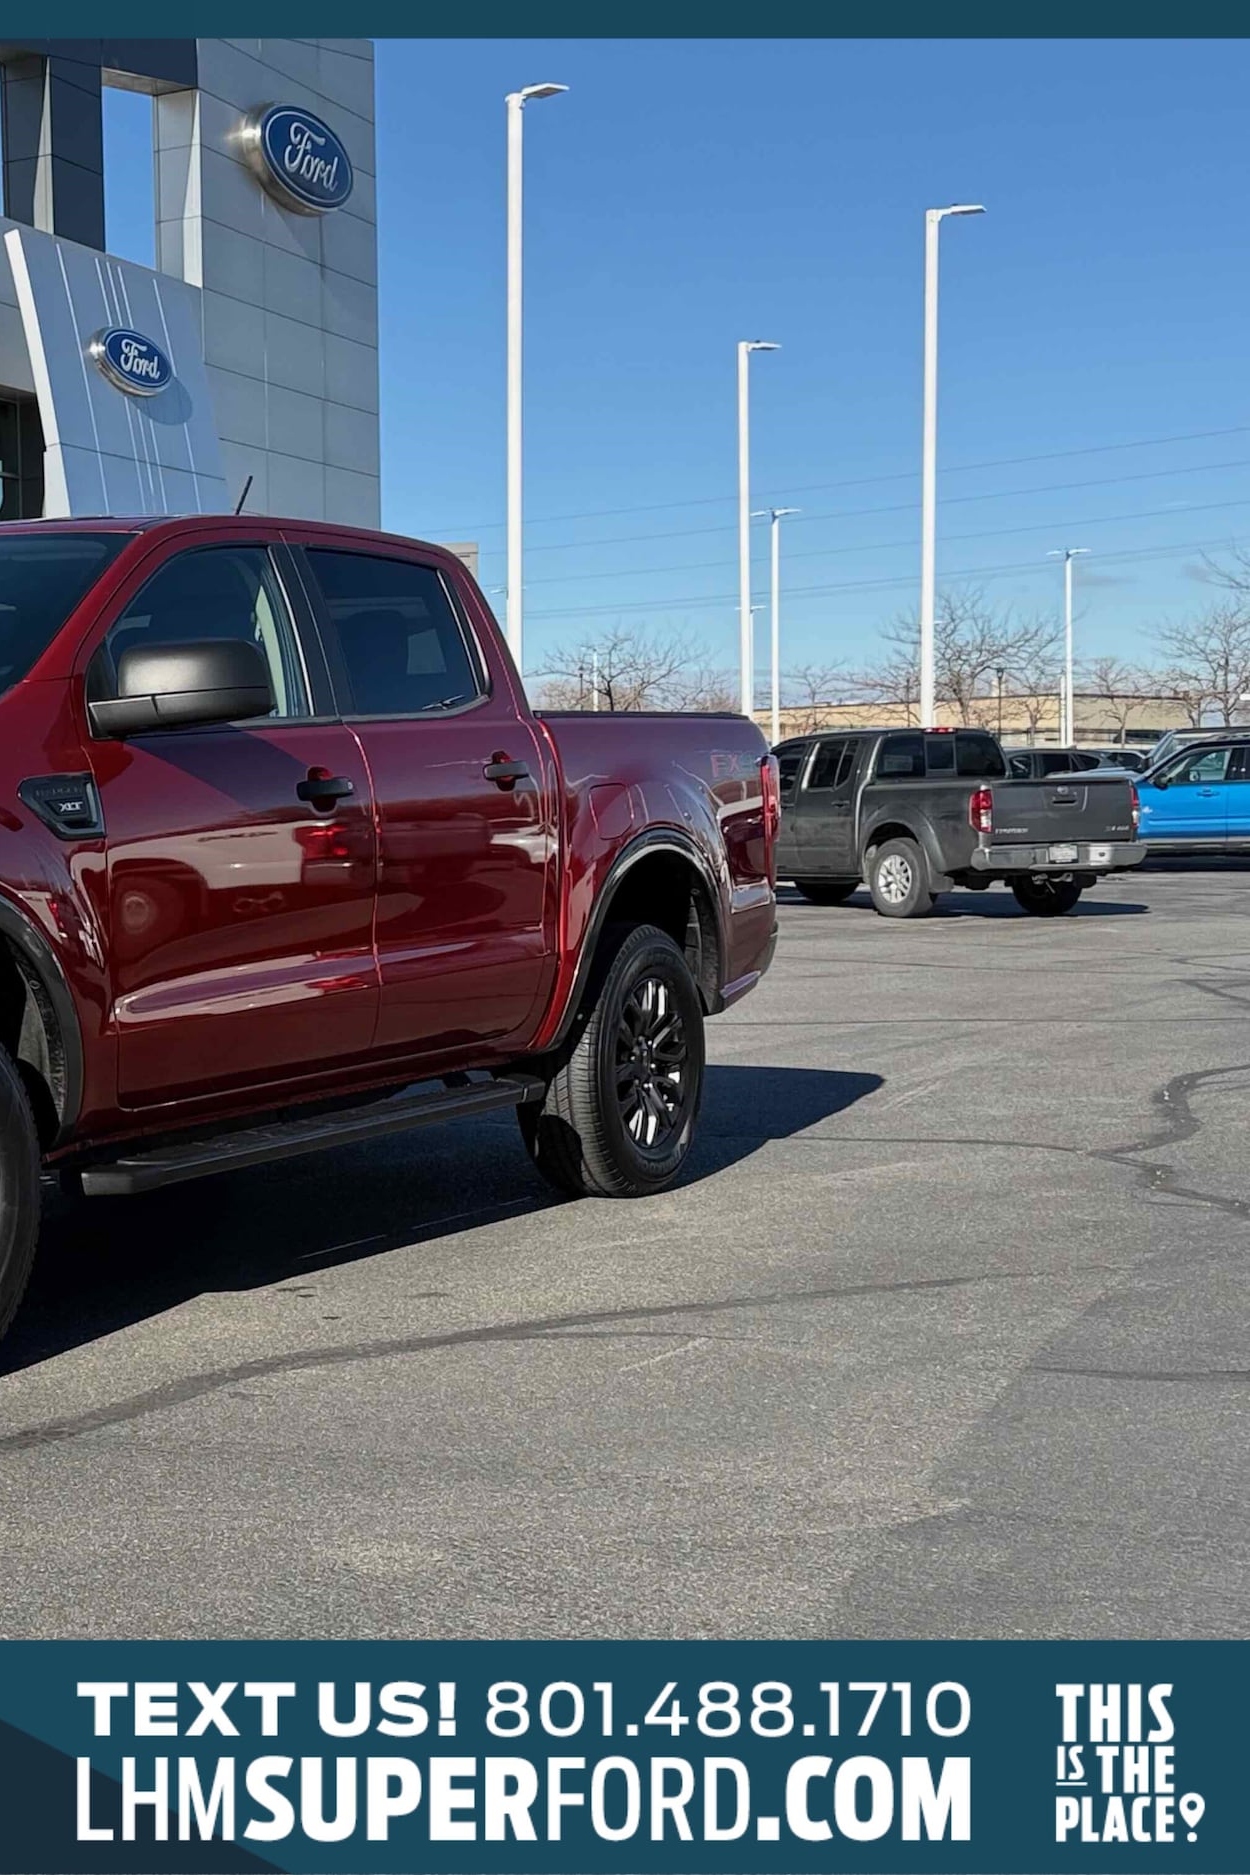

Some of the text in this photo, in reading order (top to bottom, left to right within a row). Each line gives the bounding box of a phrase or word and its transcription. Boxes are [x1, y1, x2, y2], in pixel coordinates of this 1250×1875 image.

[284, 121, 339, 192] Ford
[119, 338, 161, 380] Ford
[710, 753, 755, 778] FX
[58, 801, 83, 813] XLT
